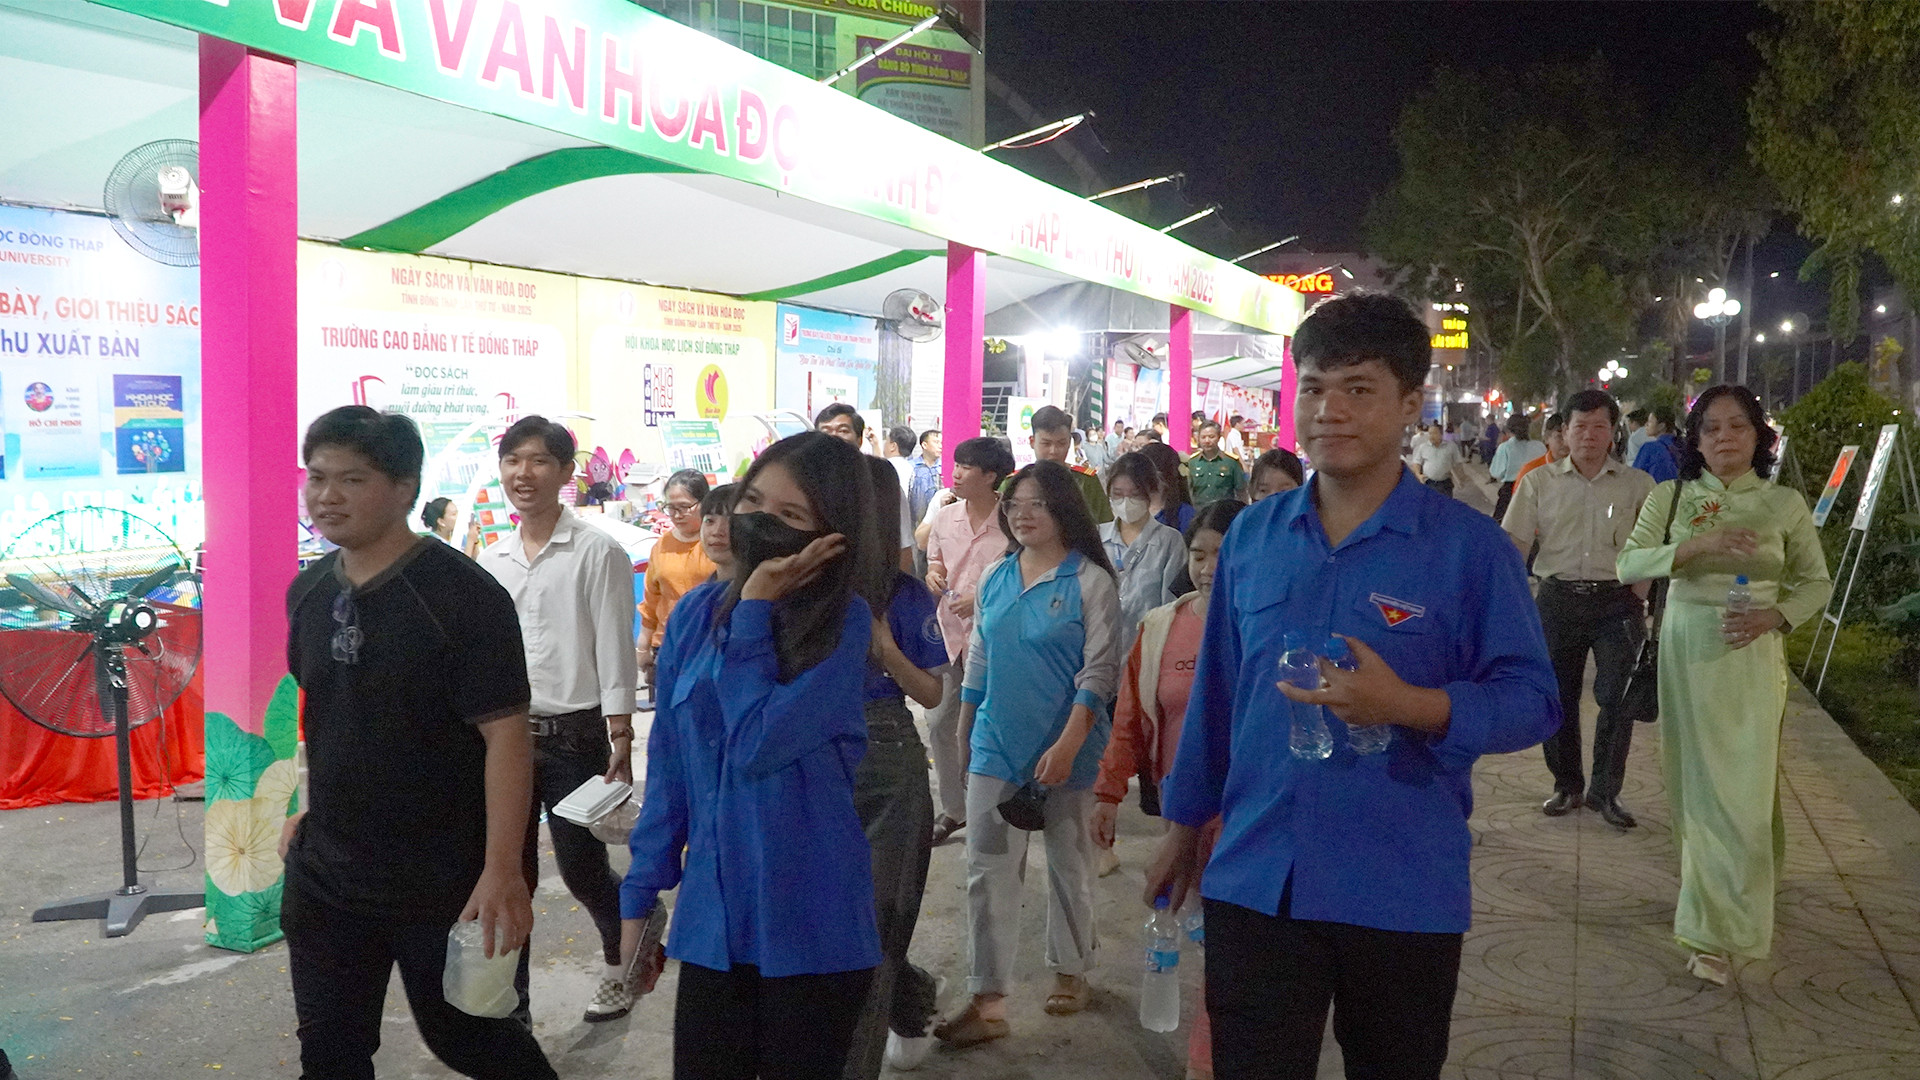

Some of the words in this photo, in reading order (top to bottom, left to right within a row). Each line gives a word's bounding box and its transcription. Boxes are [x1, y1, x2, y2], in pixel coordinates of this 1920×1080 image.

[0, 250, 71, 269] UNIVERSITY
[391, 265, 422, 287] NGÀY
[1190, 267, 1214, 306] 2025
[320, 322, 379, 350] TRƯỜNG
[382, 329, 409, 351] CAO
[450, 333, 459, 353] Y
[639, 336, 660, 351] KHOA
